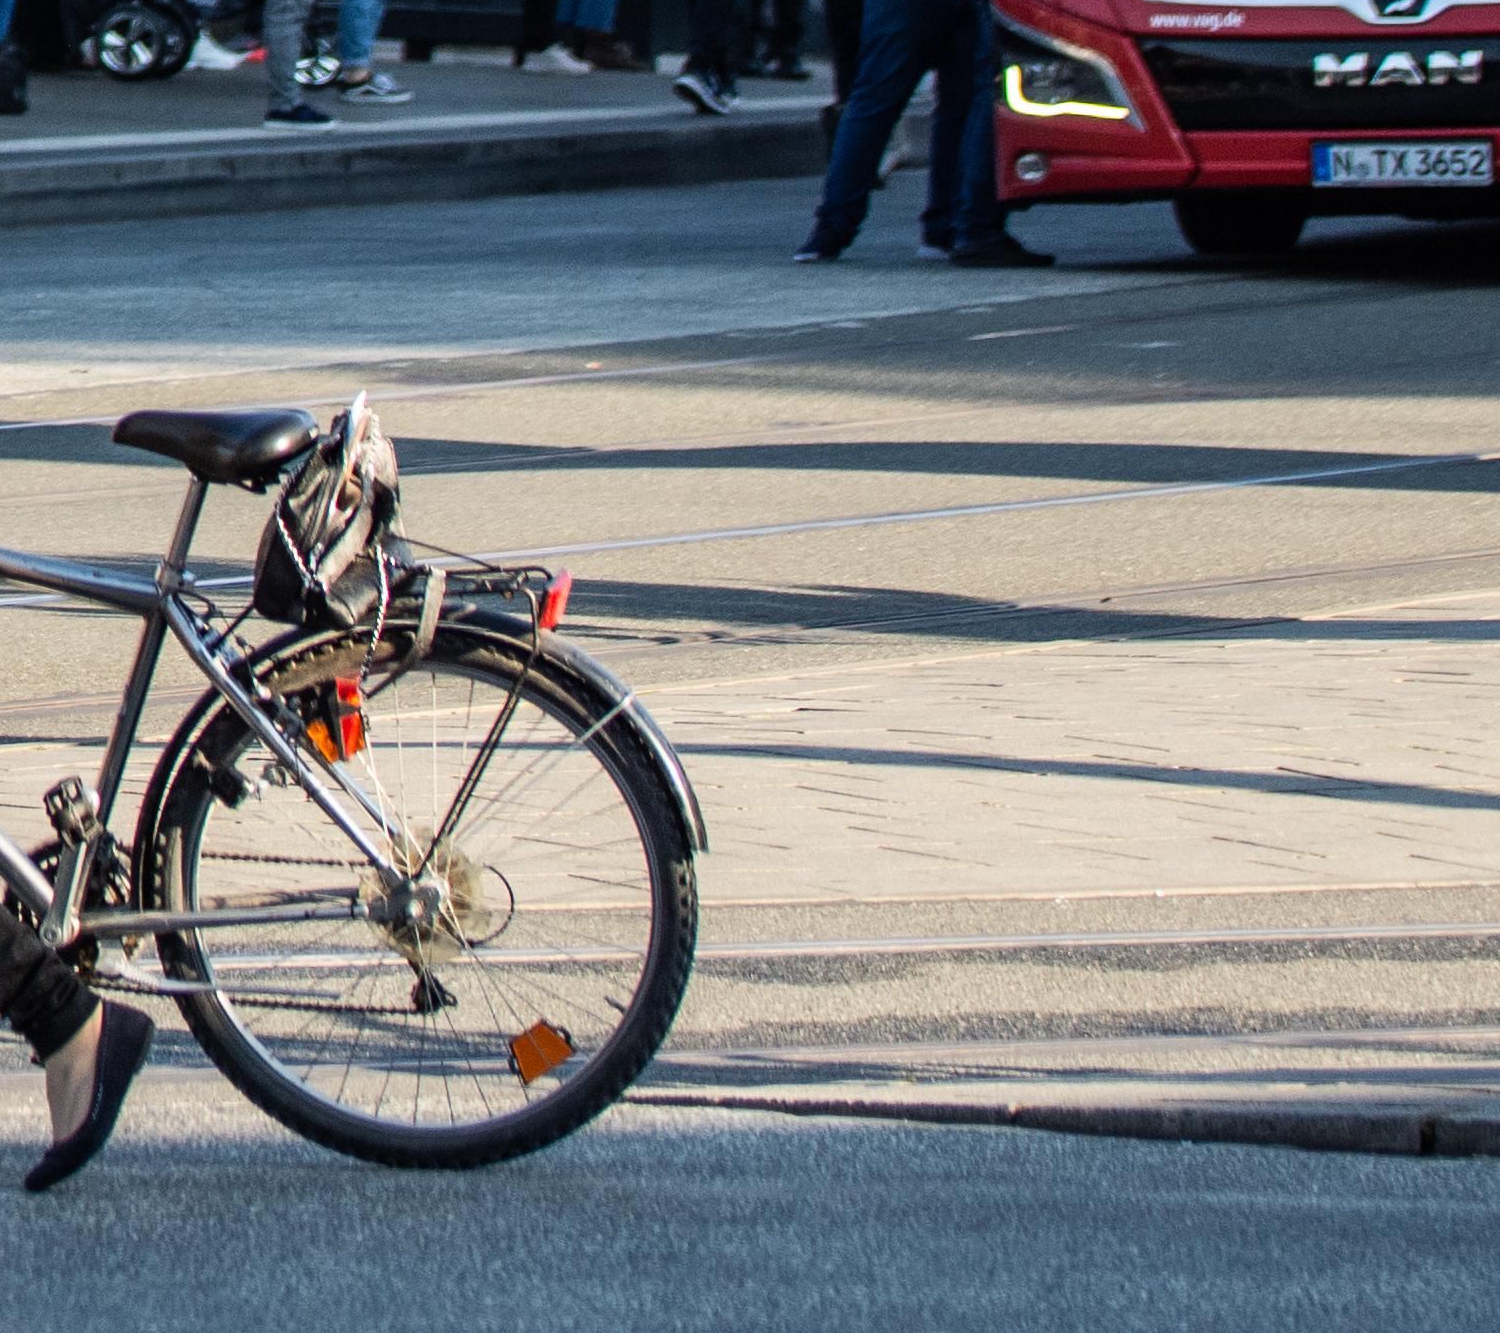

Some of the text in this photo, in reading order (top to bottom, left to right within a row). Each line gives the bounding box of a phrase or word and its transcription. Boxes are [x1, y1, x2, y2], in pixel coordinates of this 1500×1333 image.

[1149, 11, 1245, 32] www.vag.de
[1311, 49, 1484, 87] MAN
[1372, 149, 1409, 176] TX
[1415, 148, 1487, 176] 3652
